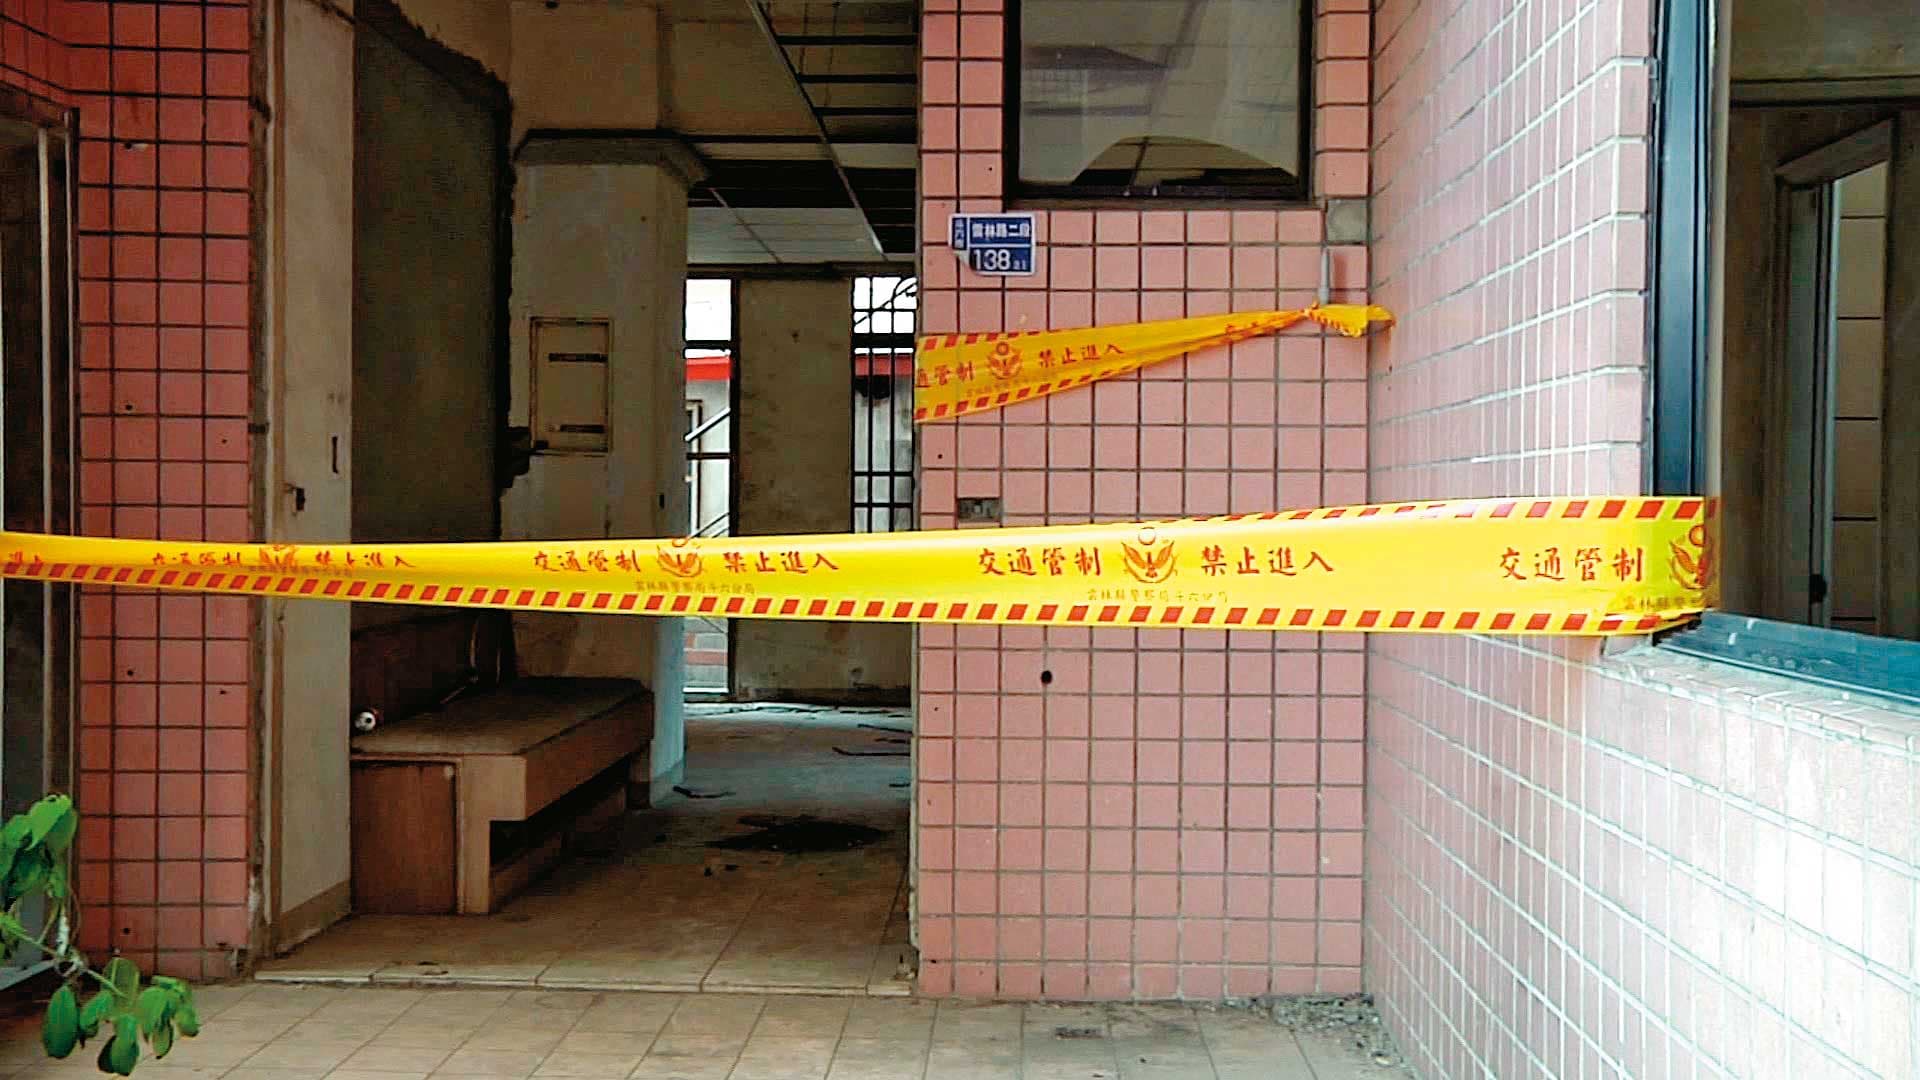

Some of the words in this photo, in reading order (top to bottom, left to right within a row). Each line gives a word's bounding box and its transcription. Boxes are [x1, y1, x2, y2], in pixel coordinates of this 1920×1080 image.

[975, 248, 1011, 271] 138
[1039, 343, 1124, 369] 禁止進入
[533, 549, 641, 573] 交通管制
[723, 550, 840, 574] 禁止進入
[978, 545, 1102, 577] 交通管制
[1200, 544, 1334, 577] 禁止進入
[1499, 546, 1643, 582] 交通管制
